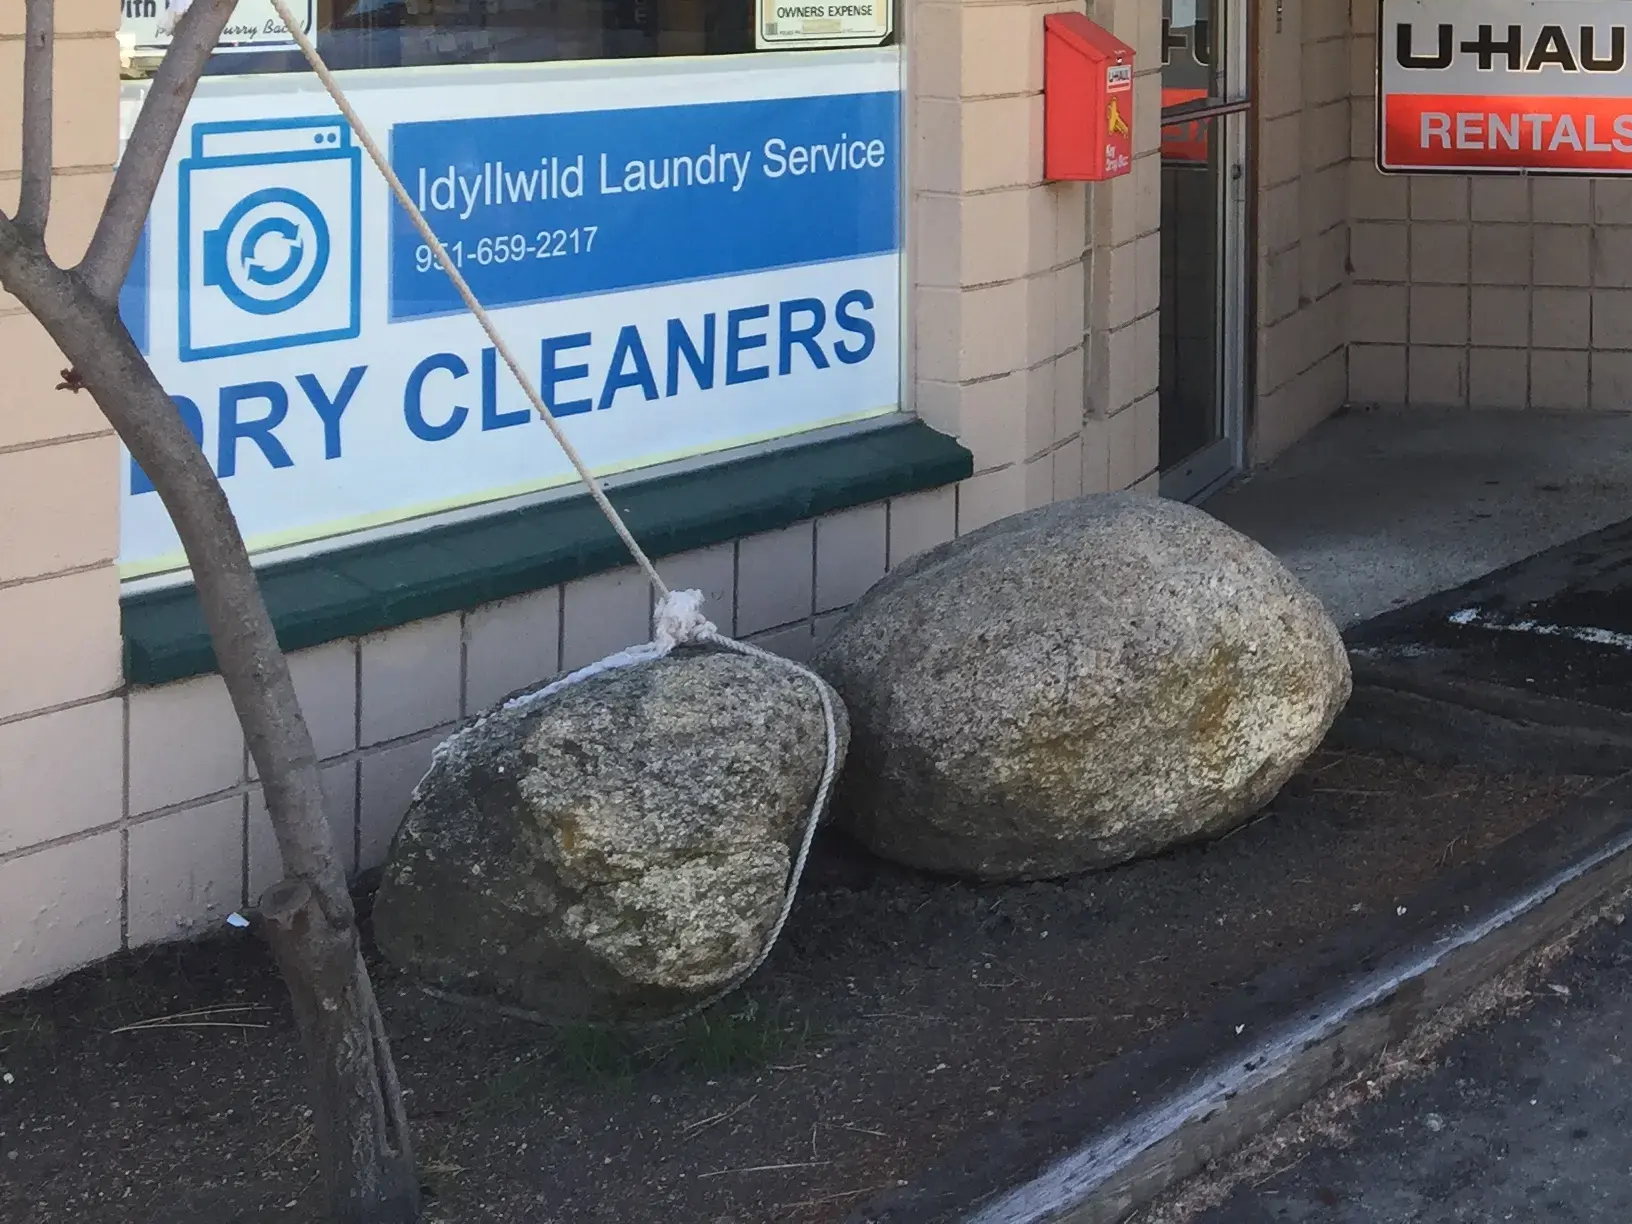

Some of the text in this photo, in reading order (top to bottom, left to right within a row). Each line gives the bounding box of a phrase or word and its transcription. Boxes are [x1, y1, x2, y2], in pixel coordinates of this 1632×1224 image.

[223, 18, 304, 39] urry Bac!
[777, 5, 873, 19] OWNERS EXPENSE
[417, 131, 886, 220] Idyllwild Laundry Service
[403, 288, 877, 443] CLEANERS
